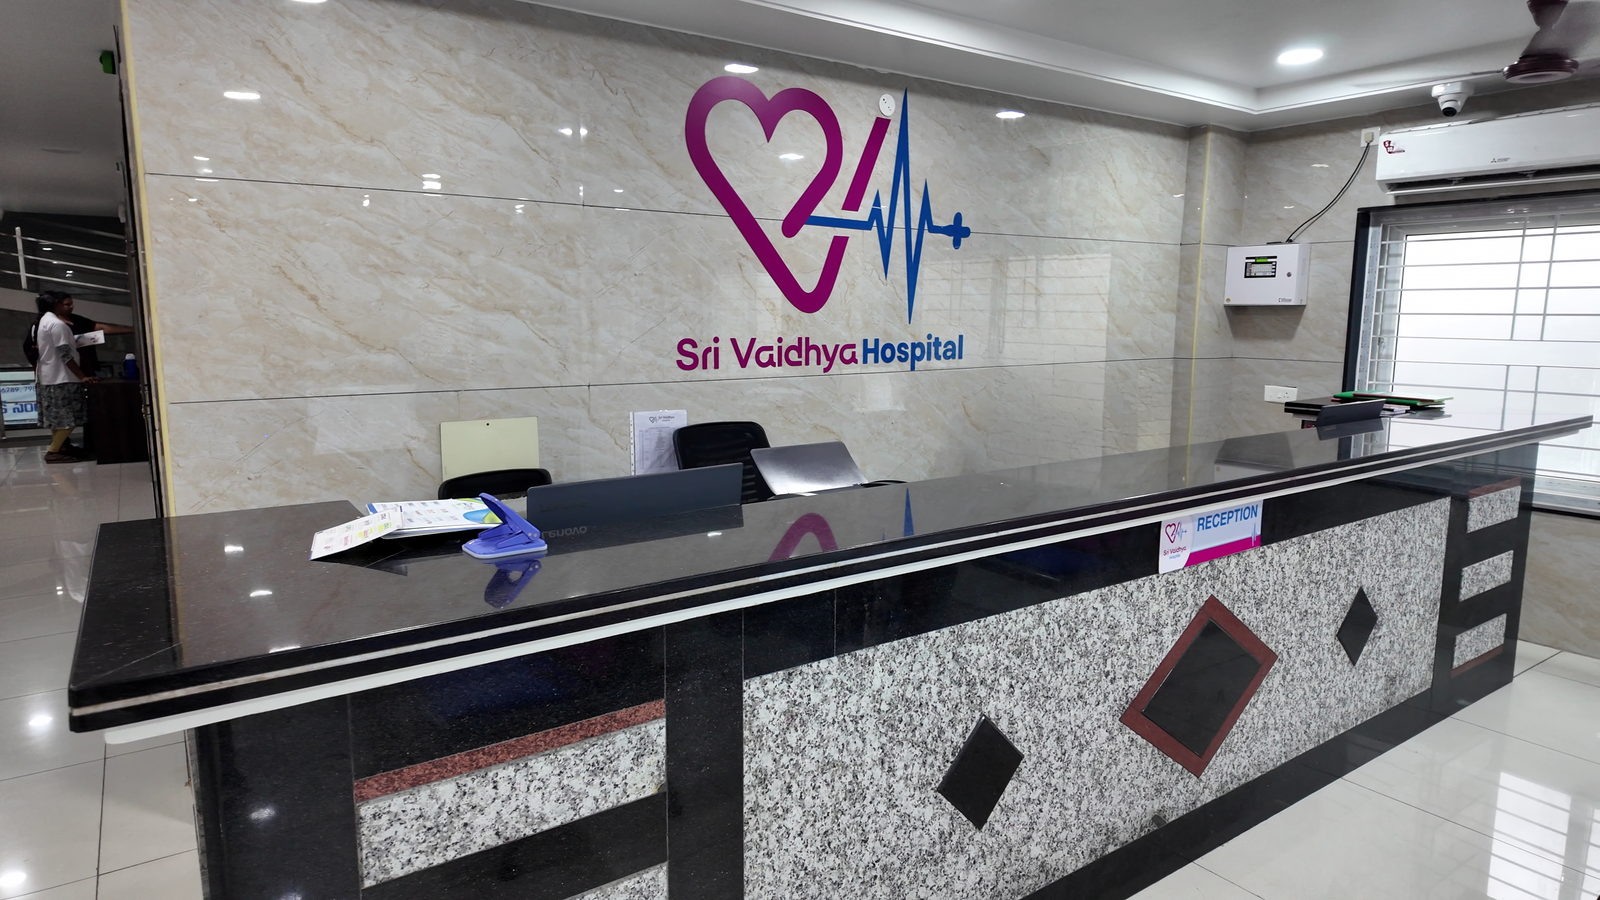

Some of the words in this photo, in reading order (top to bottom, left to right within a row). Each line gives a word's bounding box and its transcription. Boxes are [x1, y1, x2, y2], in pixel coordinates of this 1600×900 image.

[676, 336, 720, 371] Sri
[730, 336, 858, 373] Vaidhya
[862, 333, 964, 371] Hospital
[1196, 504, 1259, 532] RECEPTION
